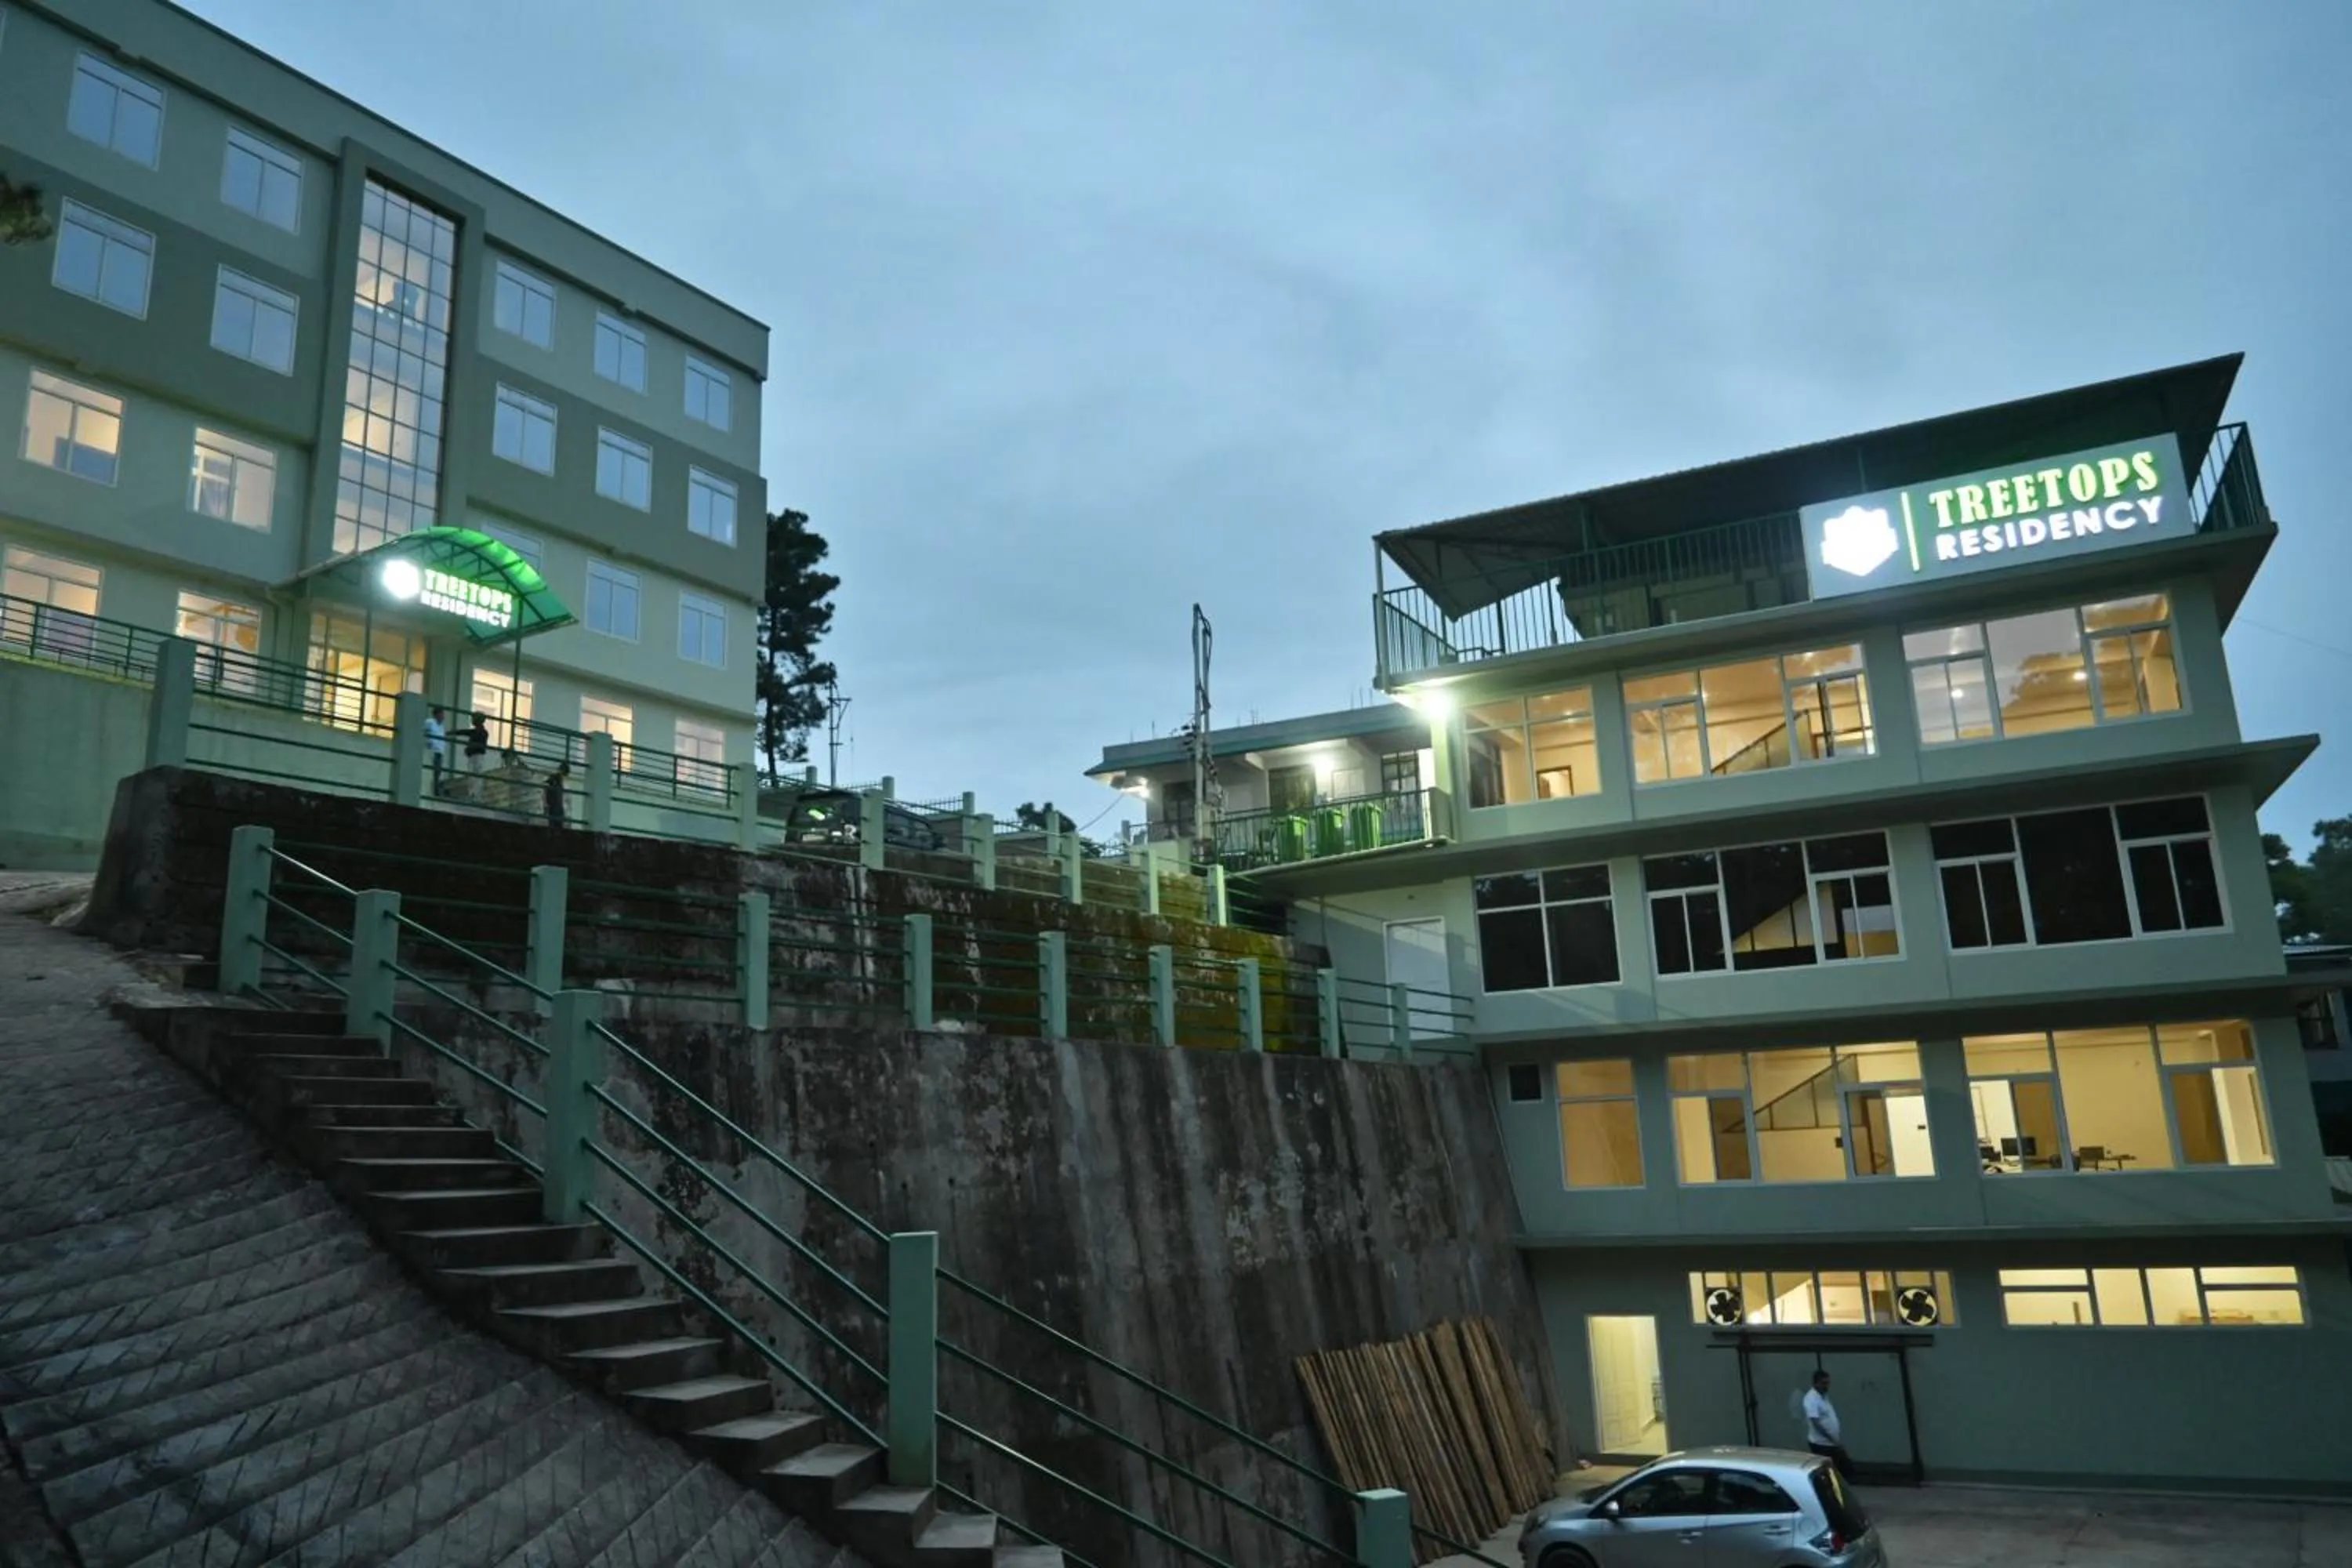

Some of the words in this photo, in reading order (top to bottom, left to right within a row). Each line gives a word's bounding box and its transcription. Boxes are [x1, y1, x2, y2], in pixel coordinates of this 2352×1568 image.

[1929, 451, 2158, 528] TREETOPS
[1935, 495, 2163, 561] RESIDENCY
[421, 590, 511, 627] RESIDENCY
[425, 568, 512, 612] TREETOPS
